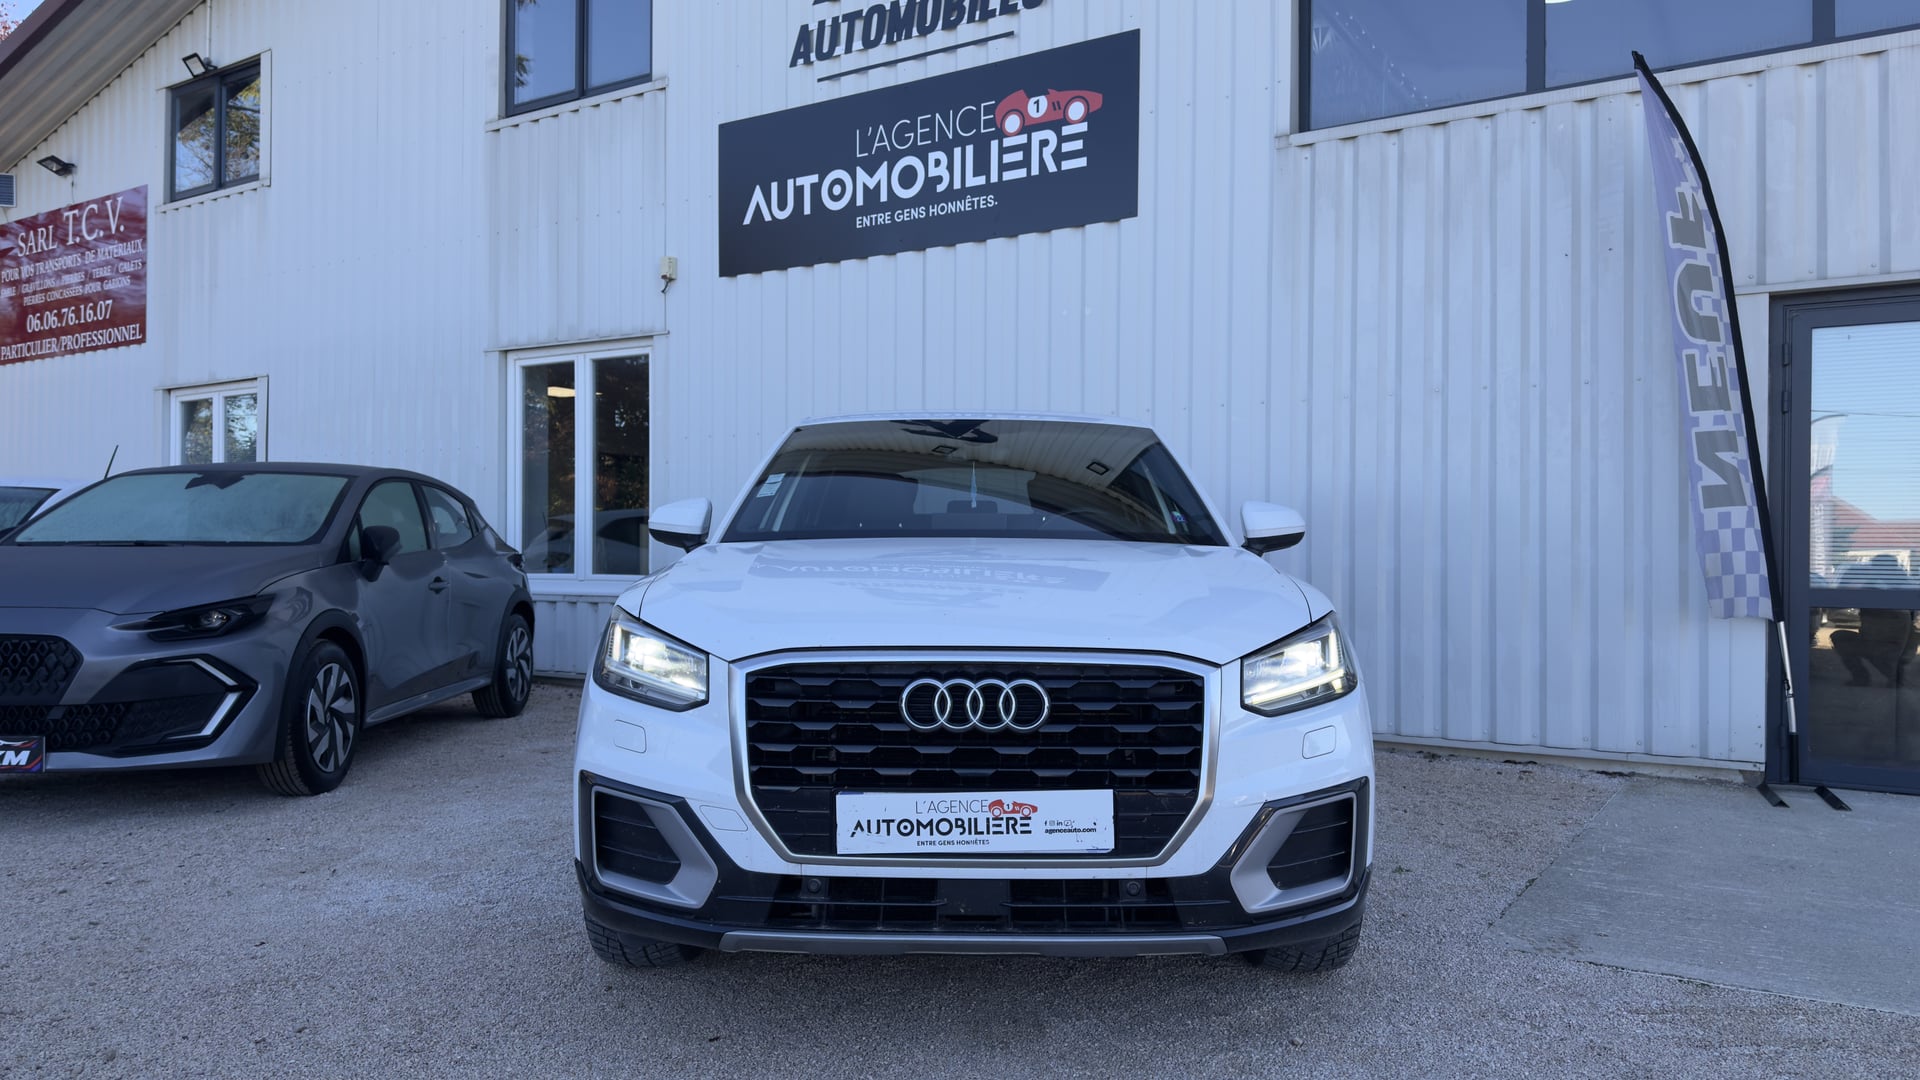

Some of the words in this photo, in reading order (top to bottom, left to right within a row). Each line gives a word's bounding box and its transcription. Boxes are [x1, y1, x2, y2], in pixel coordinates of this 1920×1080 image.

[789, 0, 1044, 68] AUTOMOBIL
[17, 225, 58, 257] SARL
[63, 196, 125, 246] T.C.V.
[856, 210, 892, 229] ENTRE
[894, 205, 927, 222] GENS
[929, 195, 999, 217] HONNÊTES.
[1, 268, 20, 283] POUR
[20, 264, 35, 279] VOS
[35, 253, 82, 276] TRANSPORTS
[85, 250, 96, 265] DE
[21, 279, 56, 294] GRAVILLONS
[92, 265, 113, 279] TERRE
[118, 259, 142, 274] GALETS
[23, 293, 46, 307] PIERRES
[84, 281, 102, 295] POUR
[26, 299, 113, 334] 06.06.76.16.07
[0, 323, 142, 360] PARTICULIER/PROFESSIONNEL
[1044, 827, 1097, 835] agenceauto.com
